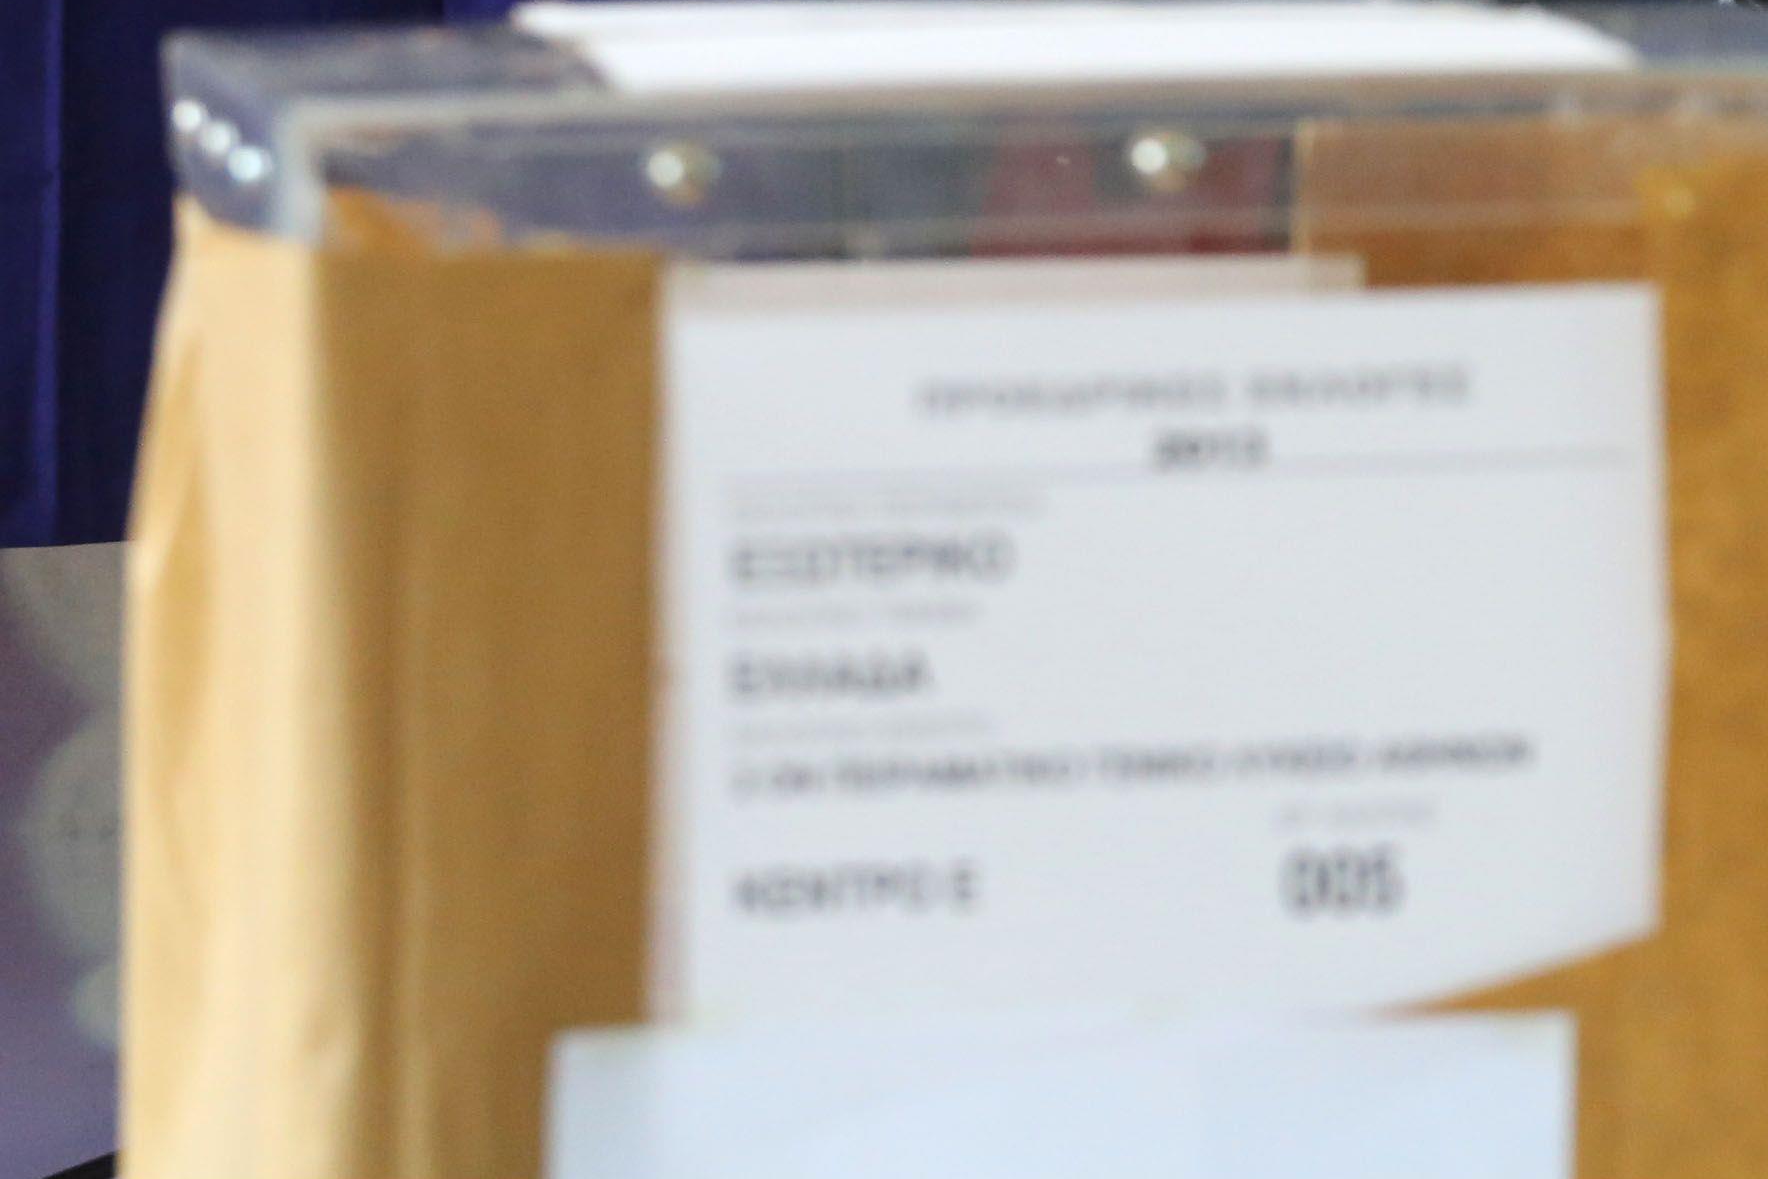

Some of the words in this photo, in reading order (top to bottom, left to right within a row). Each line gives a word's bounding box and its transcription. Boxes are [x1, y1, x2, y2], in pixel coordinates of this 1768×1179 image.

[728, 651, 929, 704] ΕΛΛΑΔΑ
[733, 866, 934, 918] ΚΕΝΤΡΟ
[1284, 845, 1402, 918] 005
